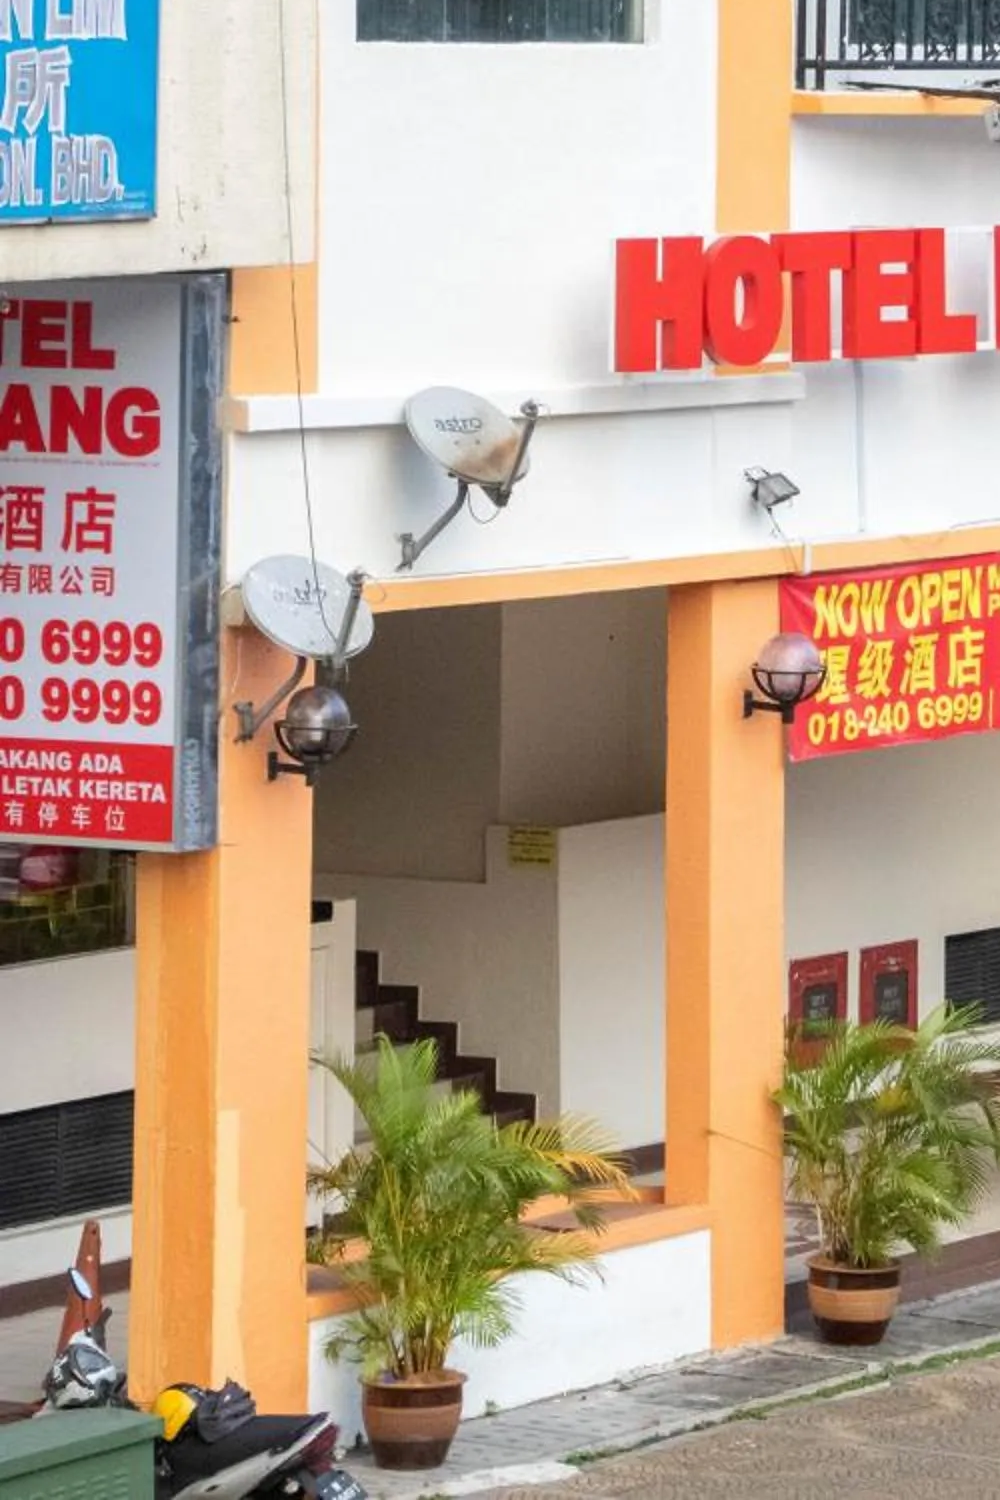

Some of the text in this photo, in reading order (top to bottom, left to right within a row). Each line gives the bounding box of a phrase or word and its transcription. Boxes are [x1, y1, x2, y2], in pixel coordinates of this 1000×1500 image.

[50, 133, 125, 206] BHD.
[614, 227, 977, 373] HOTEL
[0, 563, 116, 597] 有限公司
[813, 566, 984, 639] NOW OPEN
[41, 618, 163, 668] 6999
[41, 676, 163, 727] 9999
[808, 691, 983, 746] 018-240 6999
[78, 752, 125, 775] ADA
[1, 774, 167, 804] LETAK KERETA
[4, 799, 126, 832] 有停车位
